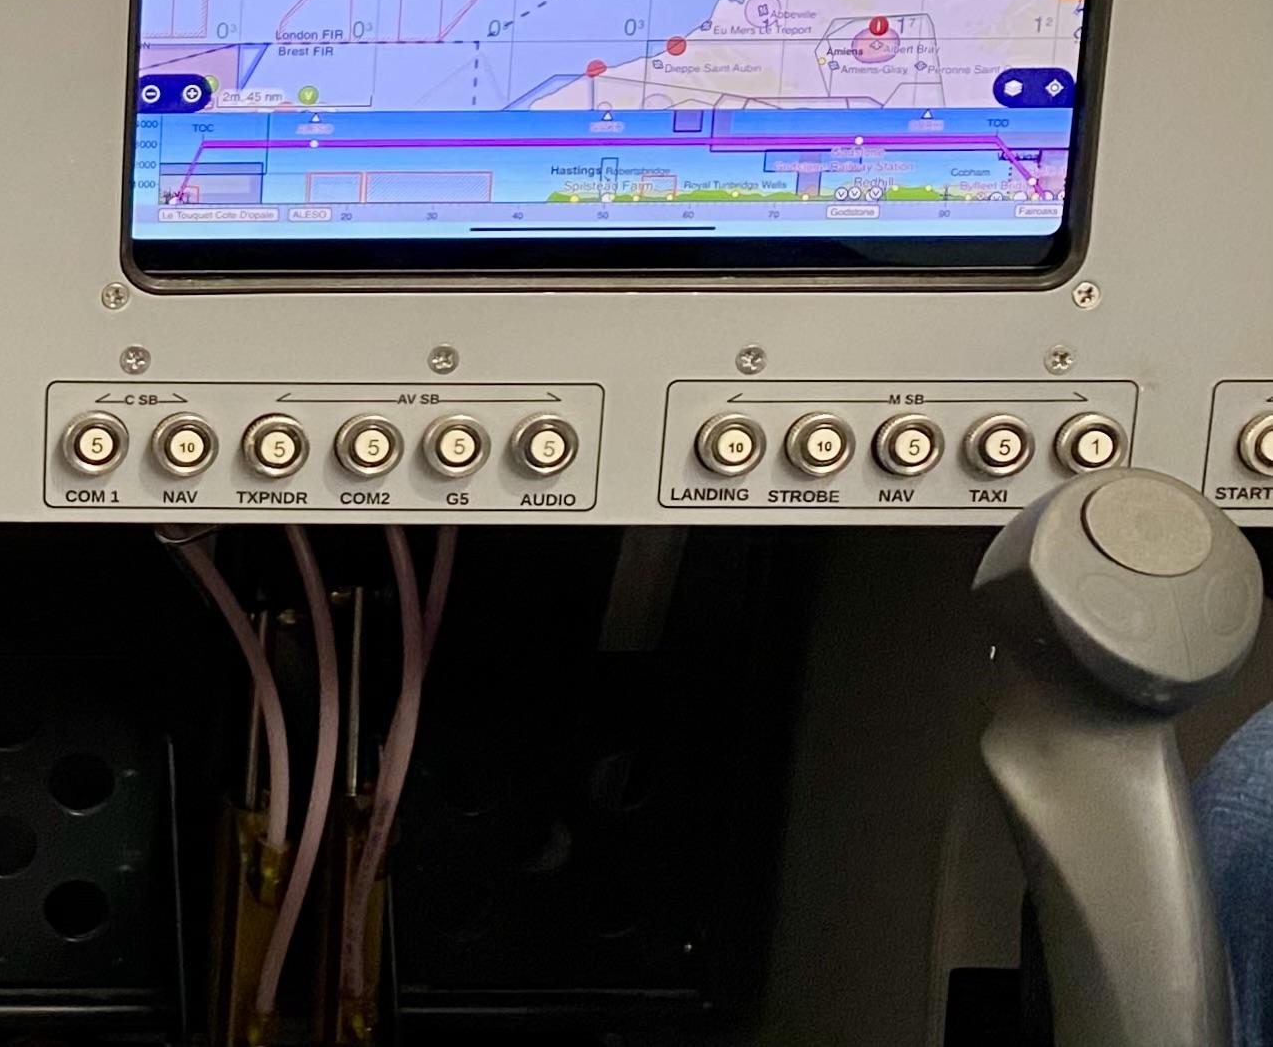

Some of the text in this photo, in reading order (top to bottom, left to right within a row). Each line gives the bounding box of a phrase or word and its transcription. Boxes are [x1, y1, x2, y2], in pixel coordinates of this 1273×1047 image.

[276, 29, 344, 41] London FIR
[551, 165, 602, 177] Hastings
[951, 168, 990, 177] Cobham
[854, 177, 895, 187] Redhill
[830, 207, 875, 216] Godstone
[163, 491, 198, 503] NAV
[237, 491, 307, 504] TXPNDR
[340, 492, 390, 505] COM2
[446, 493, 469, 505] G5
[520, 494, 576, 506] AUDIO
[671, 488, 749, 501] LANDING
[768, 490, 840, 503] STROBE
[879, 490, 914, 502] NAV
[970, 490, 1007, 502] TAXI
